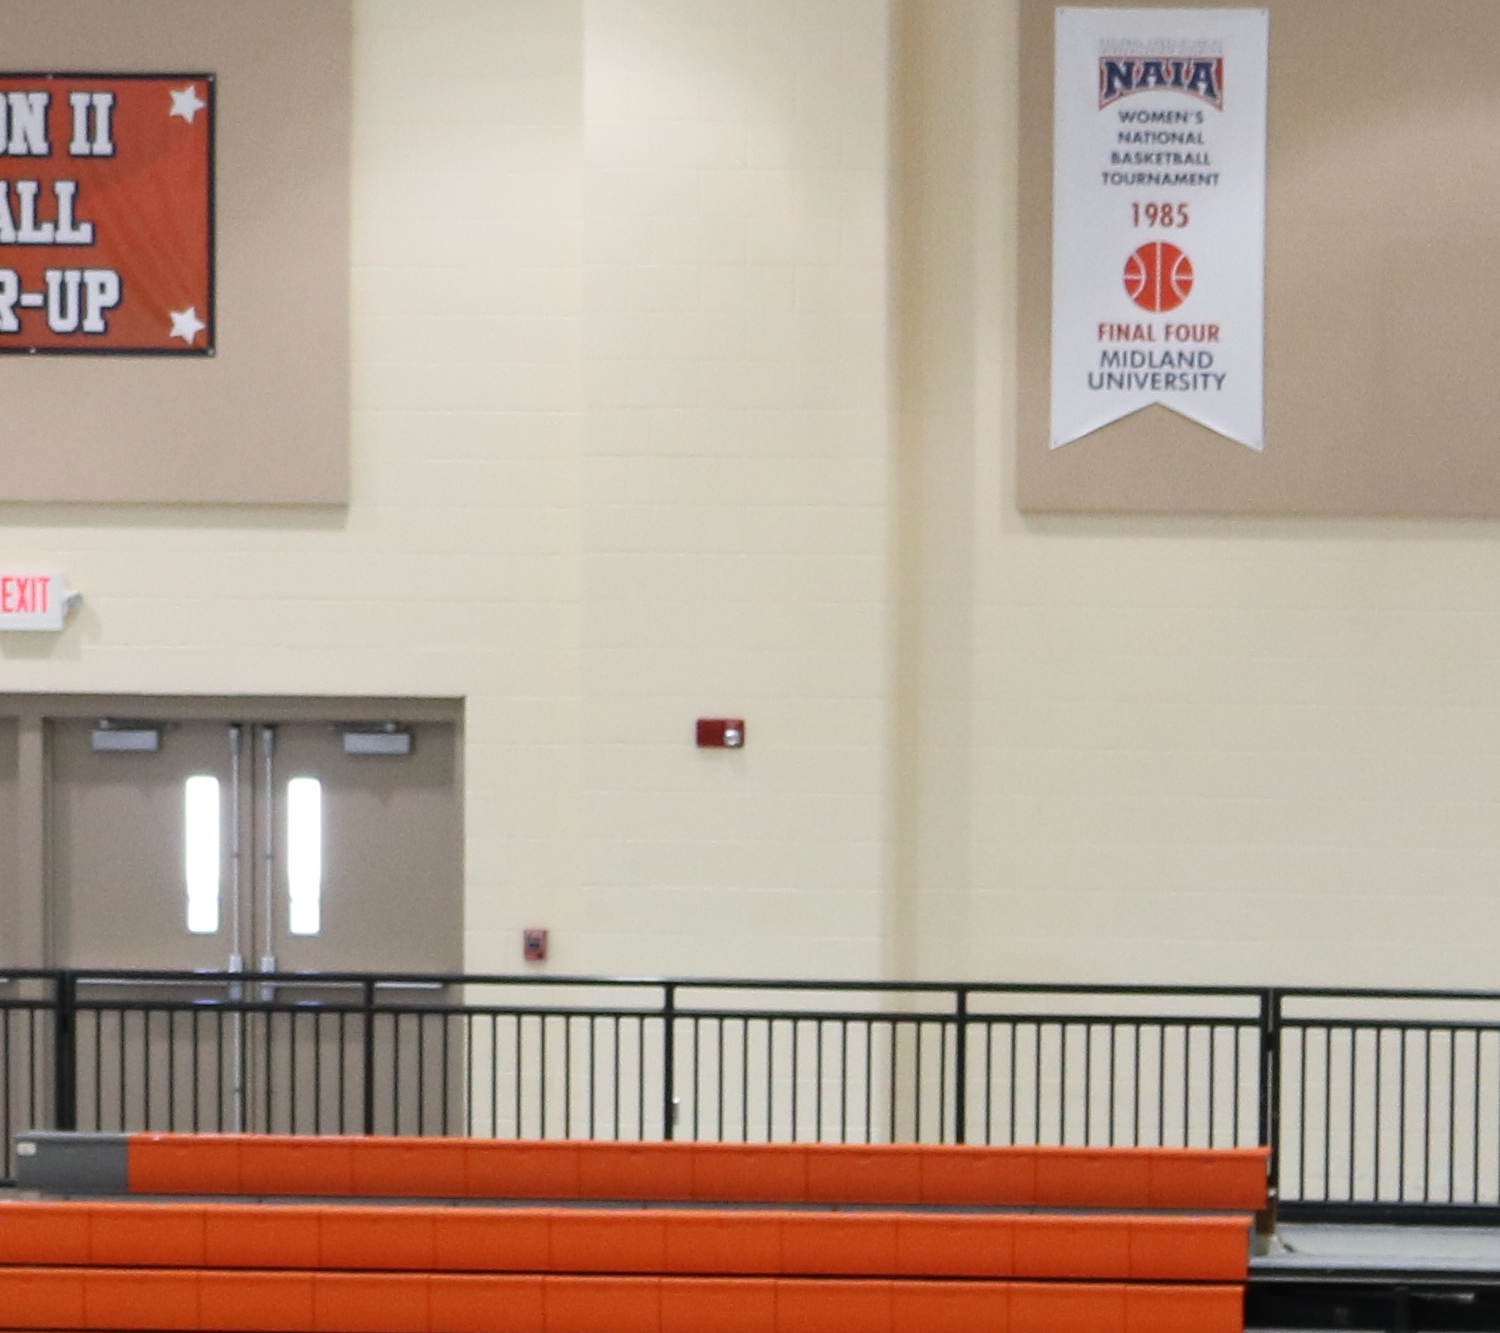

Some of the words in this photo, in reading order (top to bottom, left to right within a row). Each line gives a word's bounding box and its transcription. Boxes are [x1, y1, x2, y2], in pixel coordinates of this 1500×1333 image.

[1103, 60, 1218, 99] NAIA
[68, 91, 116, 156] II
[1118, 110, 1204, 125] WOMEN'S
[1117, 131, 1205, 145] NATIONAL
[1110, 151, 1211, 166] BASKETBALL
[1101, 171, 1220, 187] TOURNAMENT
[1131, 202, 1189, 228] 1985
[1097, 323, 1156, 342] FINAL
[1164, 323, 1220, 342] FOUR
[1100, 350, 1214, 370] MIDLAND
[1087, 372, 1227, 392] UNIVERSITY
[0, 576, 51, 613] EXIT
